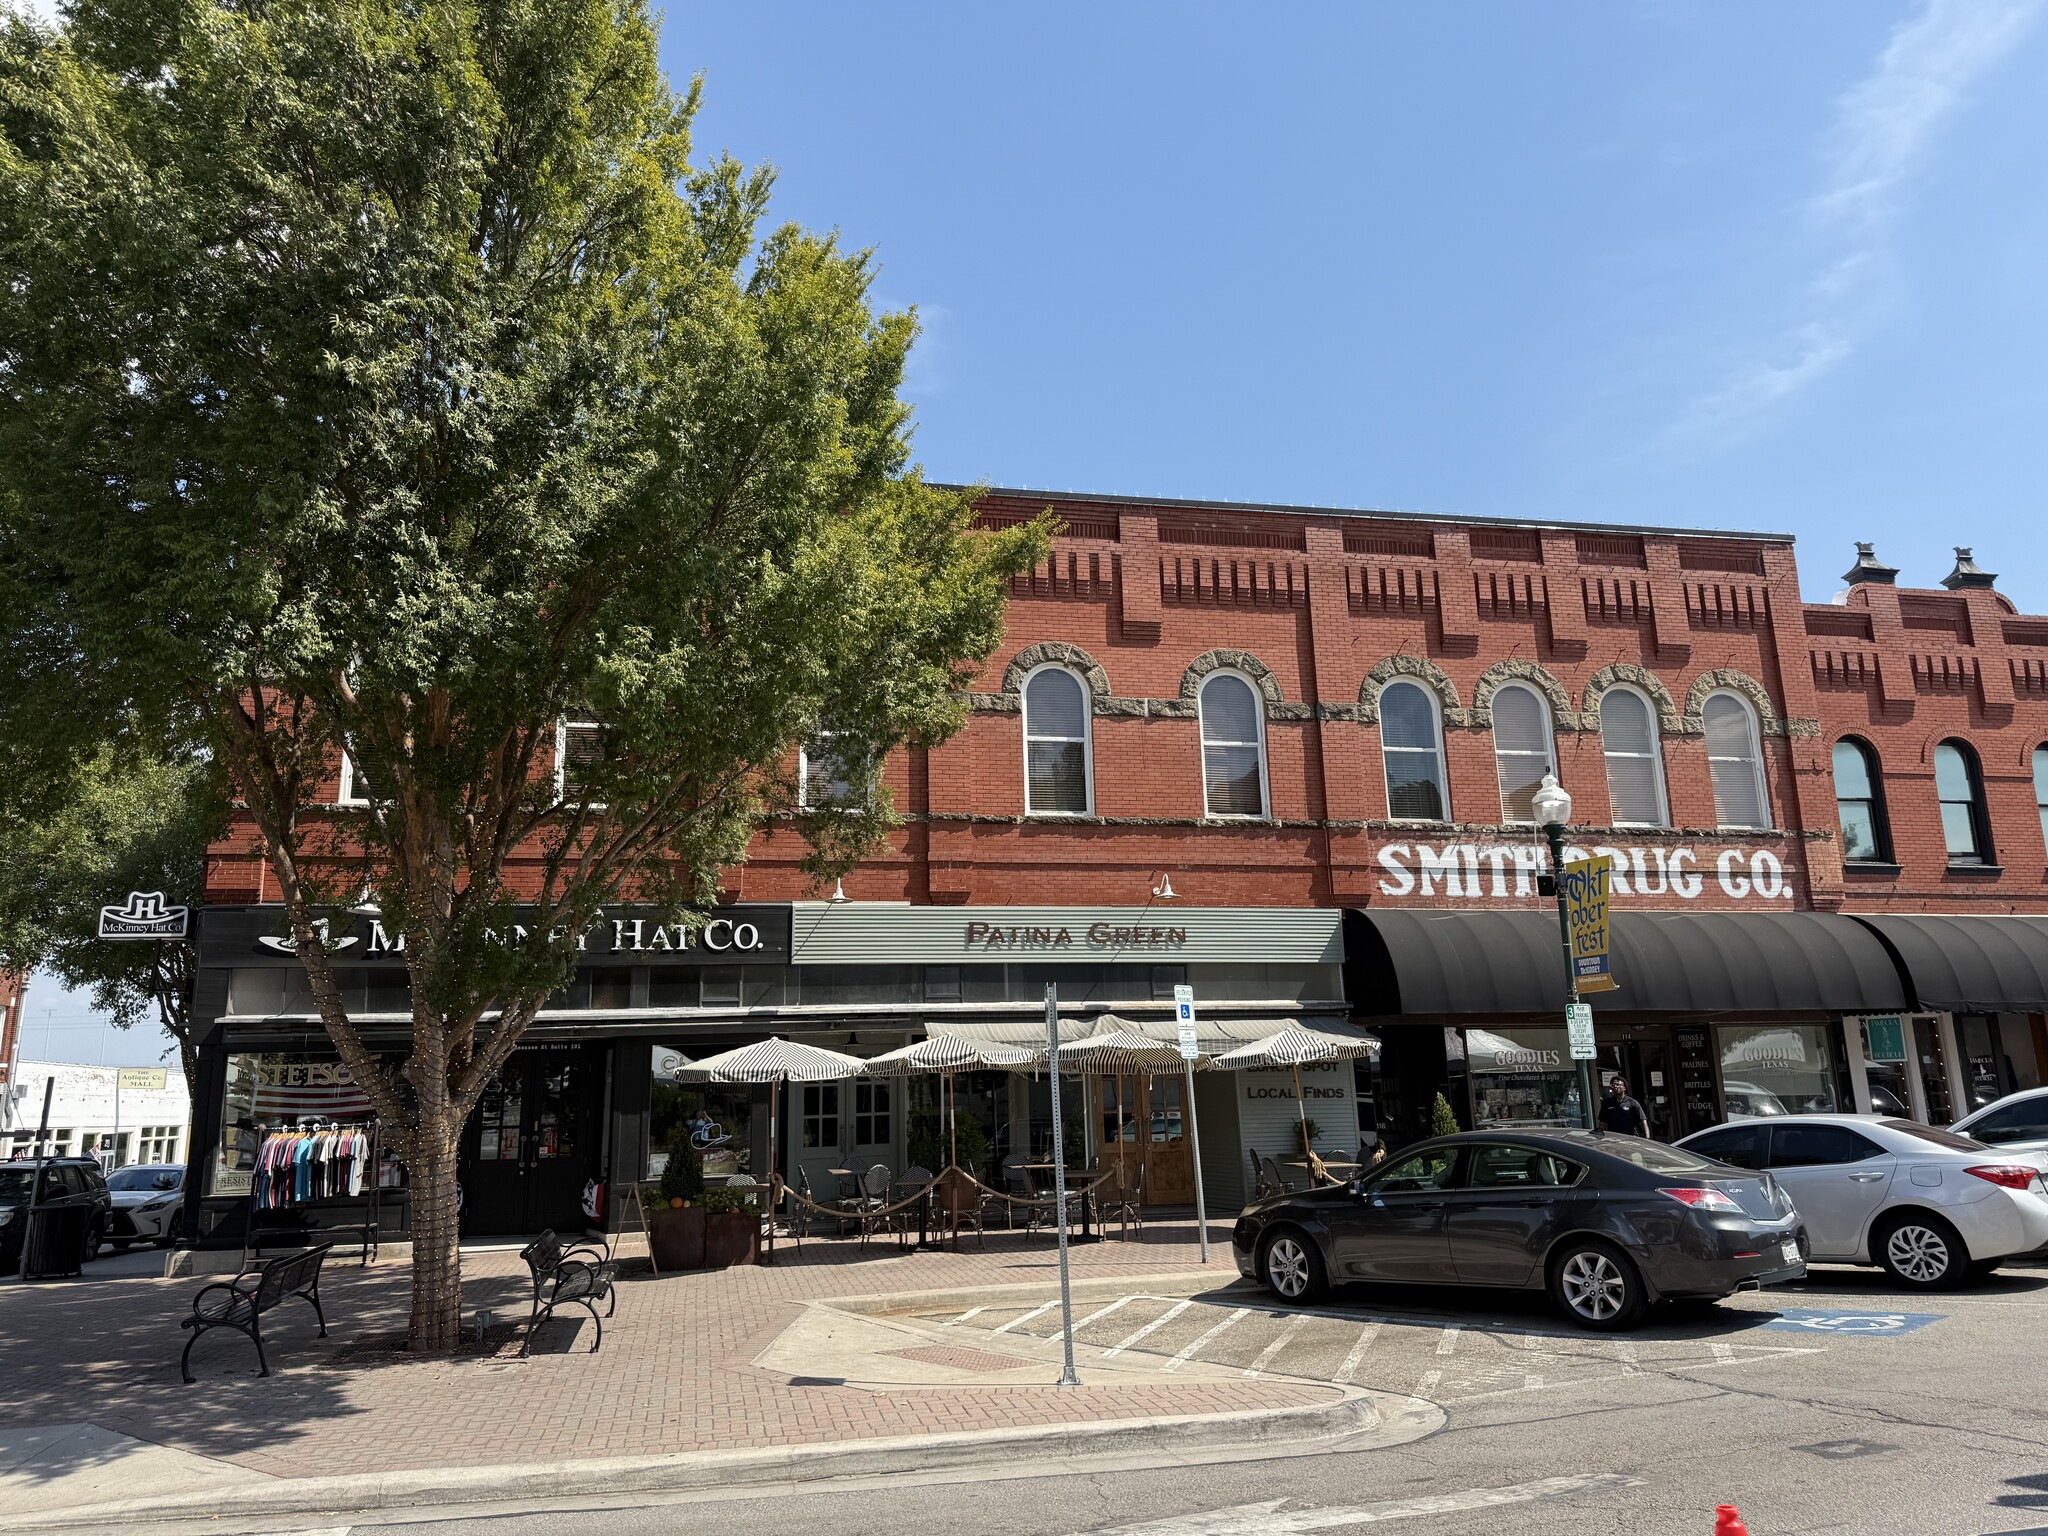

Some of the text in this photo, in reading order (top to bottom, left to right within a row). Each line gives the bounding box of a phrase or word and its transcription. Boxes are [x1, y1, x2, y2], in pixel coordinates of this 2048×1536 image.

[1376, 843, 1547, 897] SMITH
[1718, 848, 1793, 900] CO.
[1572, 896, 1605, 928] ober
[104, 923, 149, 933] McKinney
[151, 923, 166, 931] Hat
[967, 922, 1188, 944] PATINA GREEN
[1576, 924, 1605, 955] fest
[1568, 1008, 1573, 1017] 3
[1495, 1050, 1559, 1065] GOODIES
[1743, 1047, 1804, 1061] GOODIES
[1247, 1087, 1344, 1098] LOCAL FINDS
